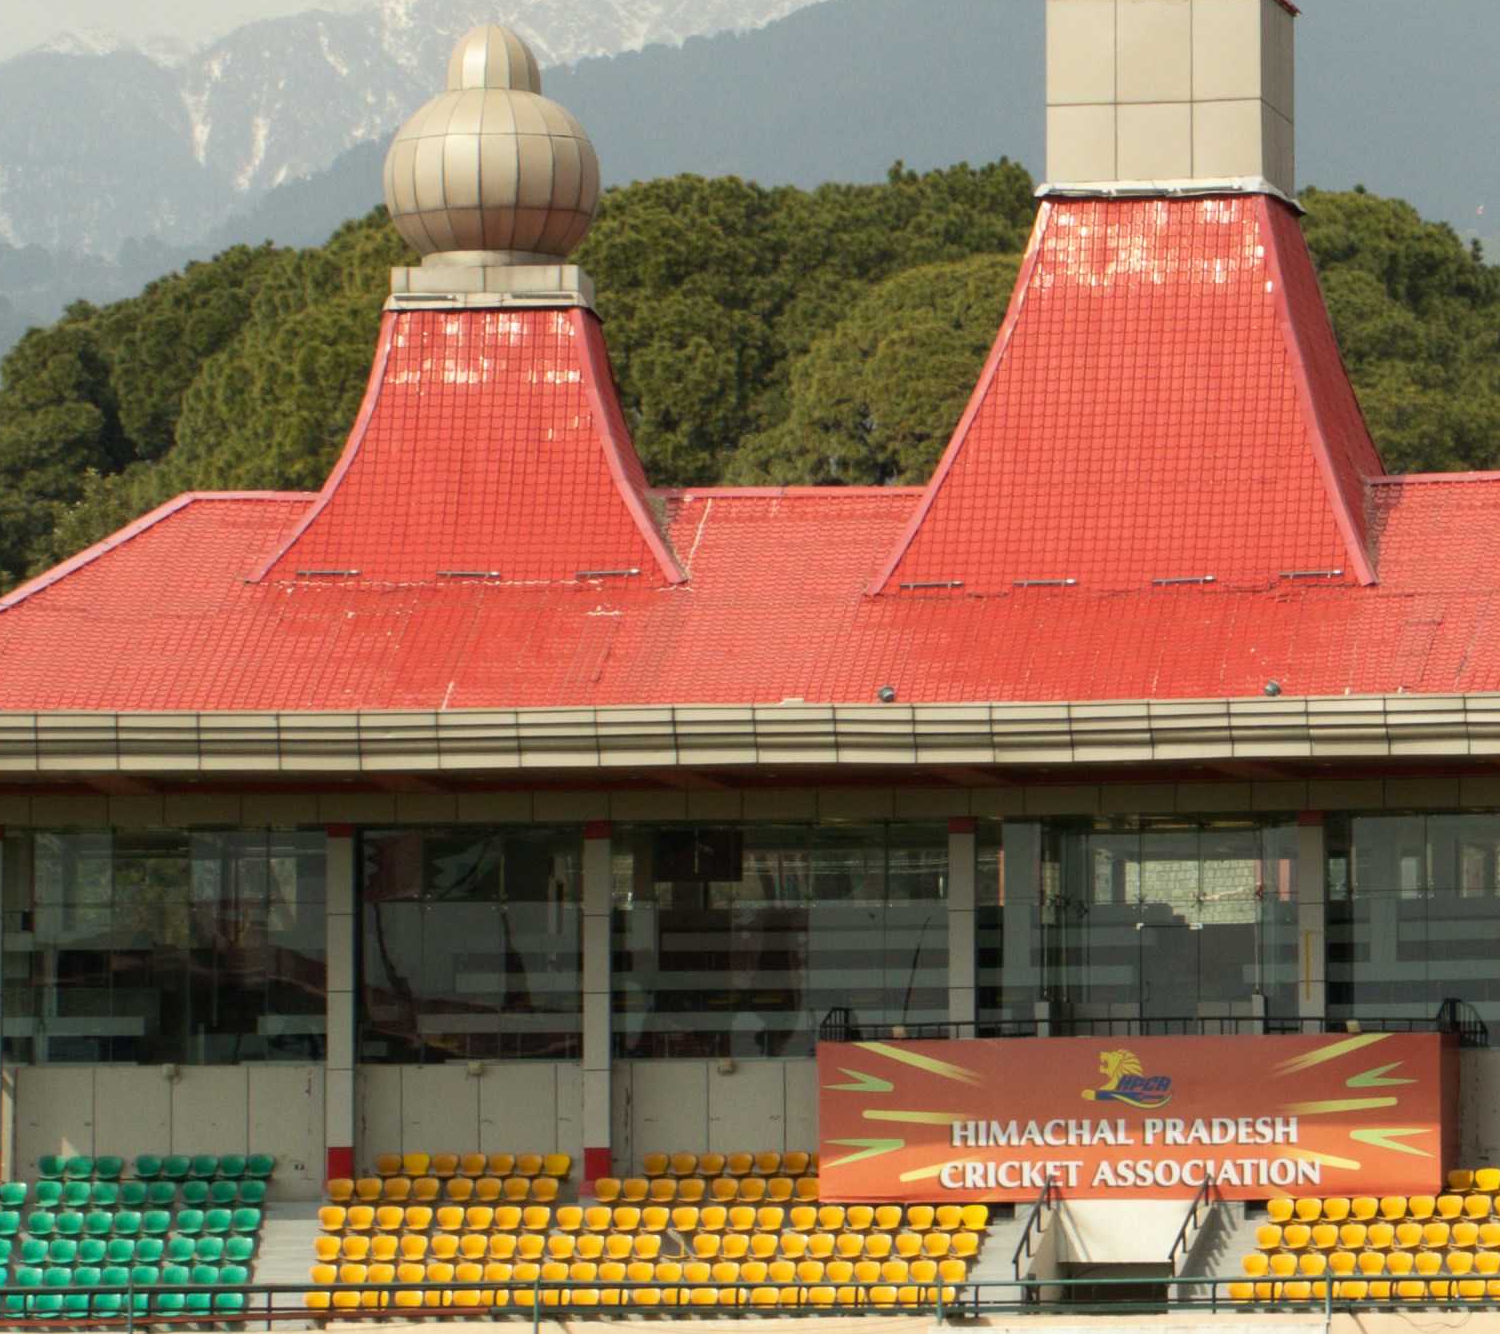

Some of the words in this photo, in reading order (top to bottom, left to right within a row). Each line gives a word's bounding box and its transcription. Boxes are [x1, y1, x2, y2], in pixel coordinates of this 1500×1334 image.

[1115, 1074, 1172, 1092] HPCA
[951, 1119, 1134, 1147] HIMACHAL
[1144, 1117, 1298, 1145] PRADESH
[940, 1161, 1084, 1189] CRICKET
[1091, 1158, 1321, 1187] ASSOCIATION
